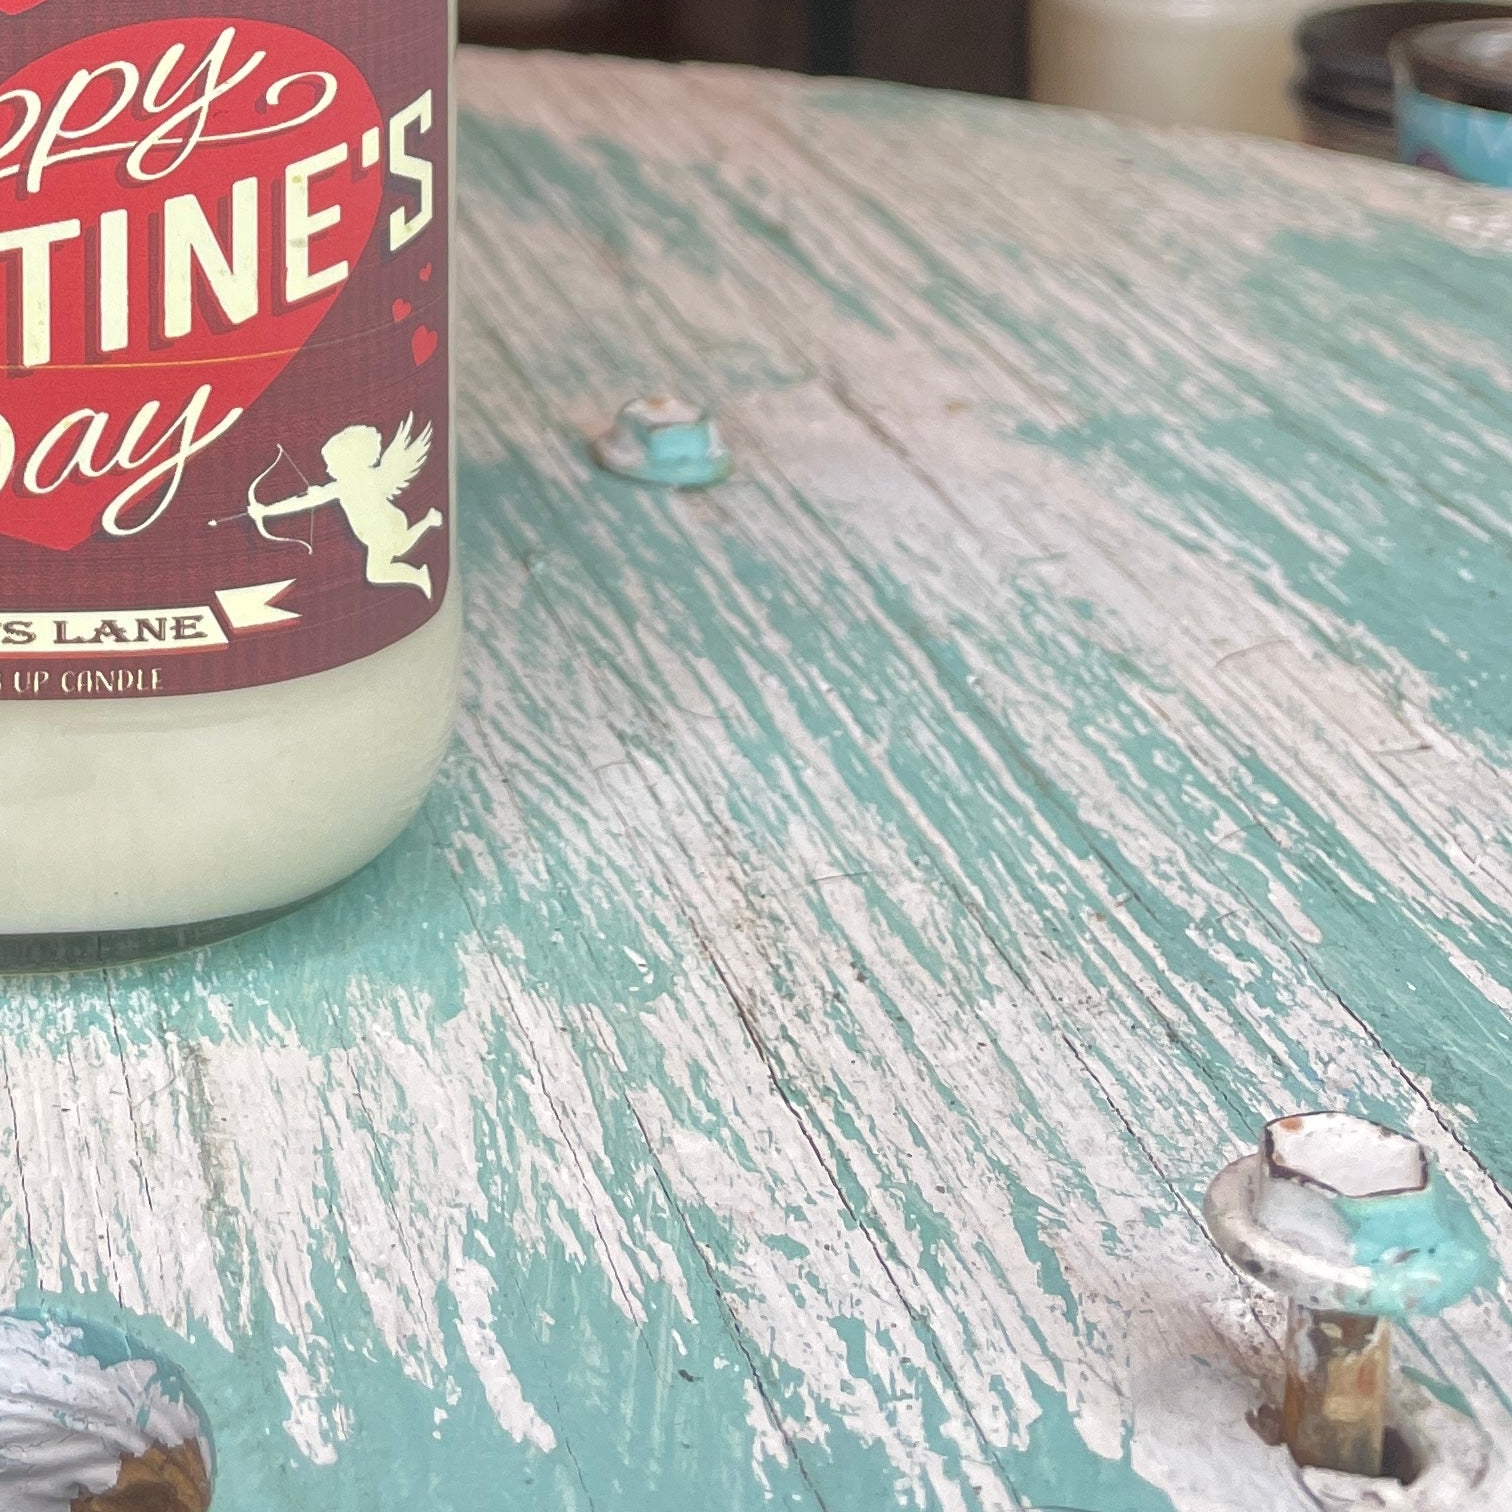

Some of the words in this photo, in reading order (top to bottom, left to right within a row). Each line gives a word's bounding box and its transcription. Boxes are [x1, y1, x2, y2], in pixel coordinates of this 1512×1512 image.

[53, 614, 210, 645] LANE
[13, 670, 50, 694] UP
[60, 667, 164, 694] CANDLE
